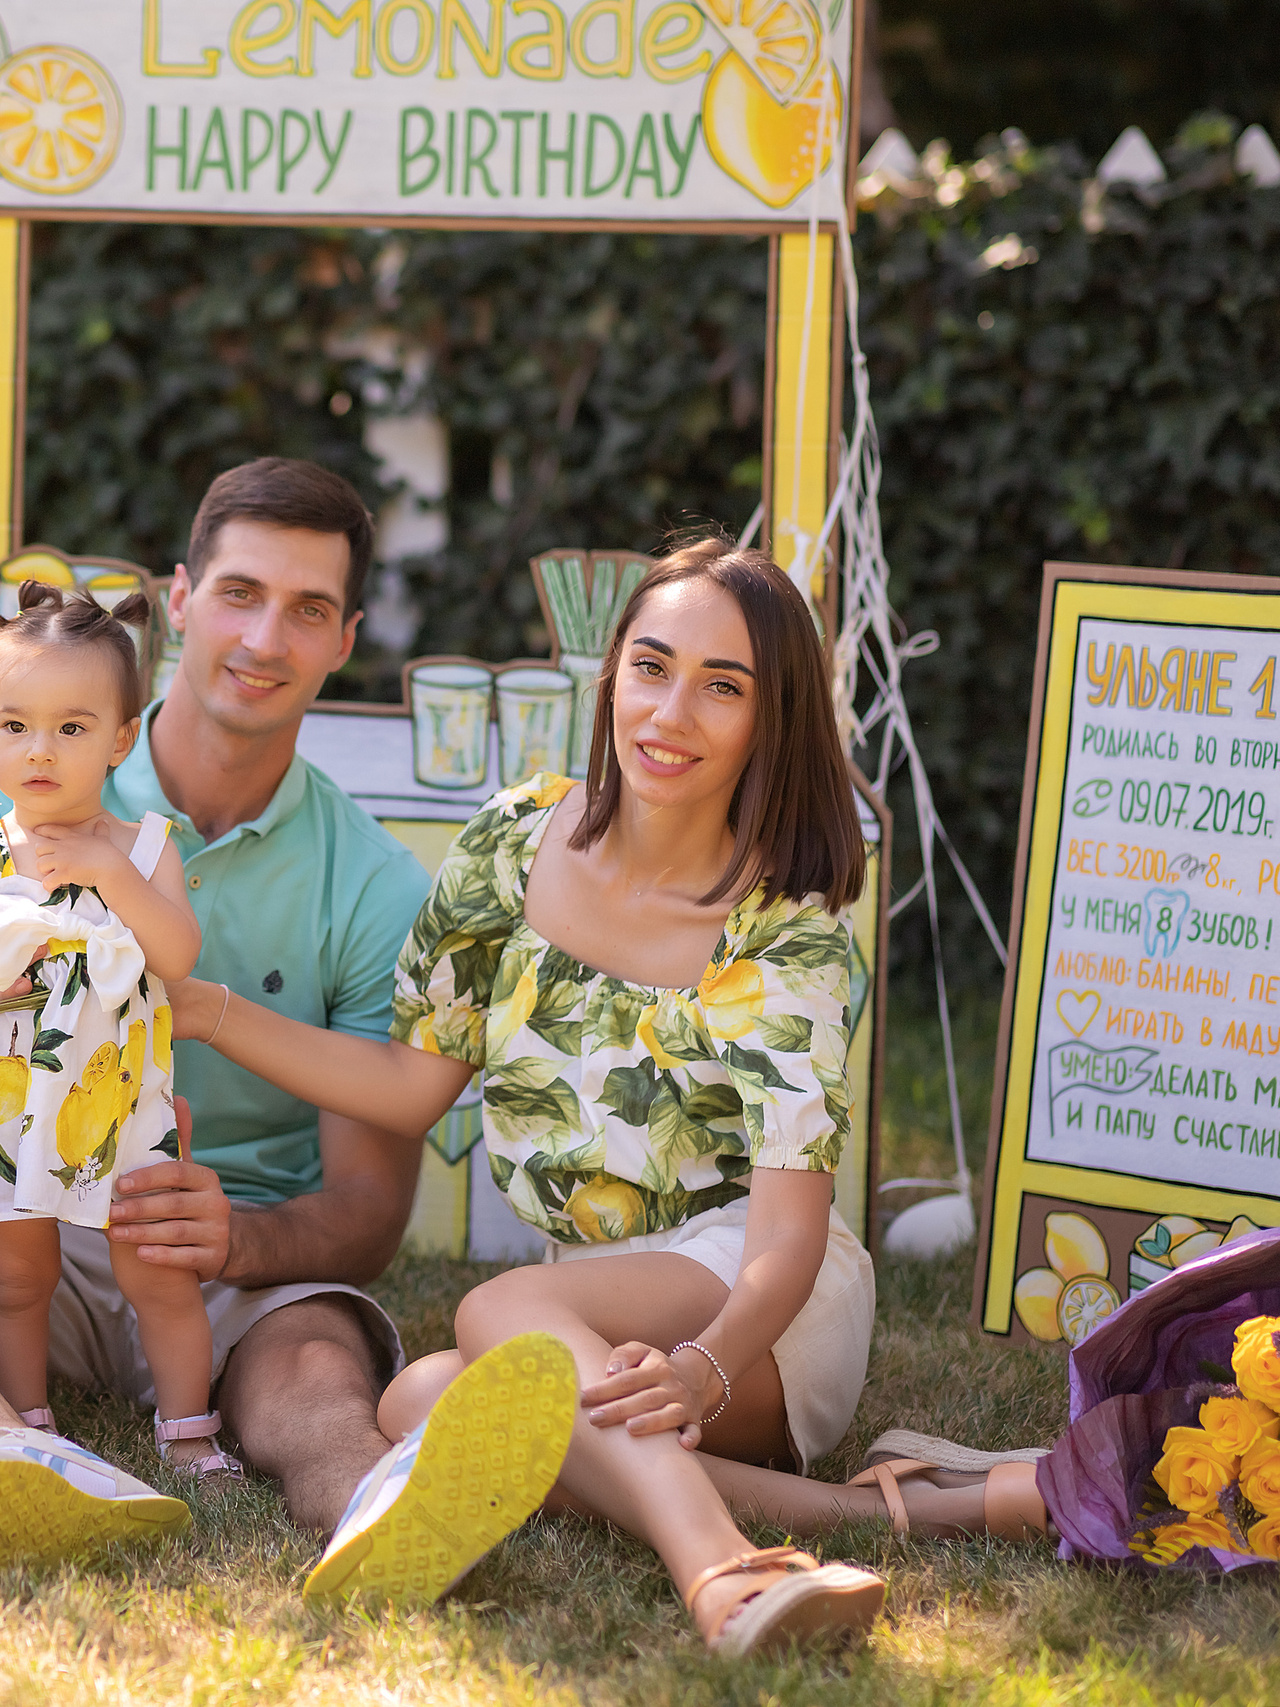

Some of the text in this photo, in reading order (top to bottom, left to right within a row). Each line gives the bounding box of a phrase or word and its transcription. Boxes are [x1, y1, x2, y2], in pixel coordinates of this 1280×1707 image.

[145, 104, 704, 200] HAPPY BIRTHDAY
[1086, 641, 1278, 720] УЛЬЯНЕ 1
[1081, 723, 1180, 761] РОДИЛАСЬ
[1194, 734, 1217, 765] ВО
[1066, 838, 1109, 878] ВЕС
[1061, 894, 1077, 929] У
[1083, 896, 1142, 935] МЕНЯ
[1156, 906, 1173, 934] 8
[1105, 1005, 1185, 1045] ИГРАТЬ
[1200, 1016, 1214, 1047] В
[1149, 1063, 1238, 1102] ДЕЛАТЬ
[1066, 1099, 1280, 1160] И ПАПУ СЧАСТЛИ
